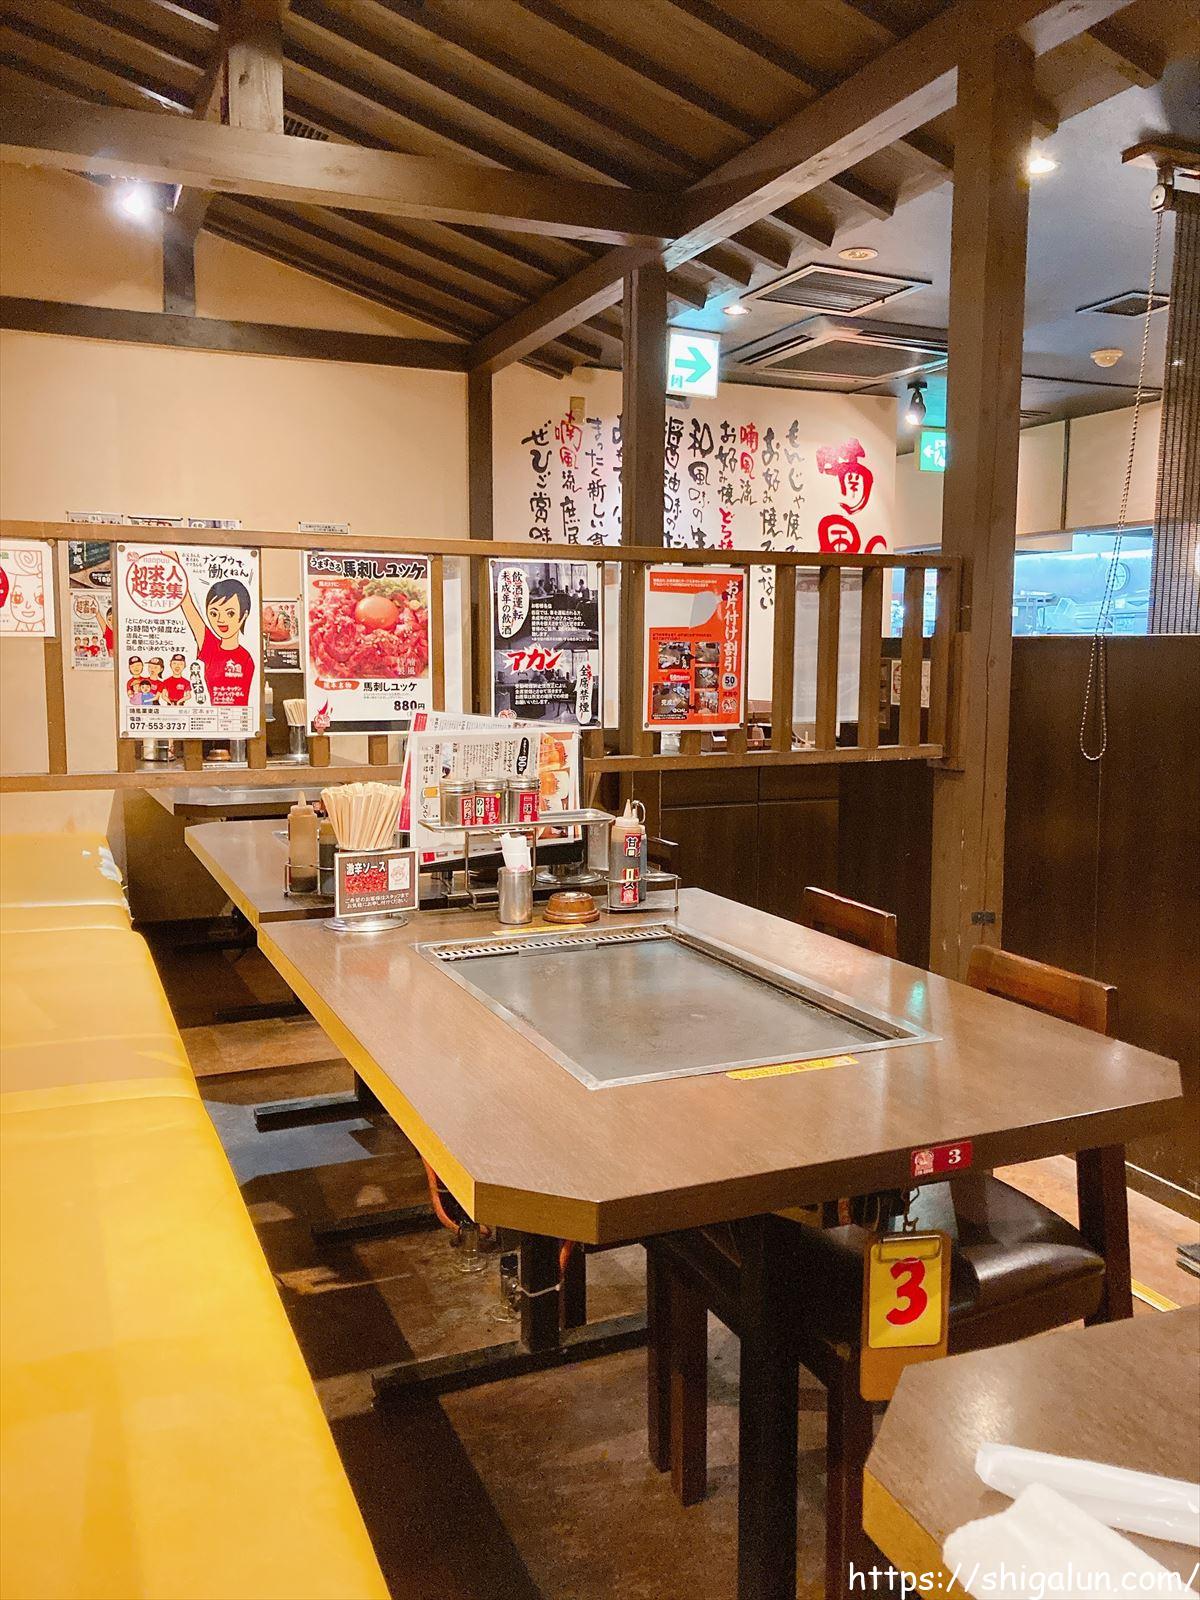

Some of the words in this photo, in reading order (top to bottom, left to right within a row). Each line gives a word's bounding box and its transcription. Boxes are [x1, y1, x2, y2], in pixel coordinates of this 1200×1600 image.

[208, 564, 249, 580] 働くねん
[343, 560, 426, 580] 馬刺しユッケ
[141, 599, 175, 608] STAFF
[501, 571, 512, 635] 未成年の飲酒
[512, 571, 524, 621] 飲酒運転
[724, 579, 739, 673] お片付け割引
[507, 648, 563, 671] アカン
[363, 681, 418, 692] 馬刺しユッケ
[394, 700, 426, 711] 880円
[476, 798, 485, 815] のり
[346, 861, 386, 876] 激辛ソース
[948, 1148, 961, 1165] 3
[885, 1256, 928, 1326] 3
